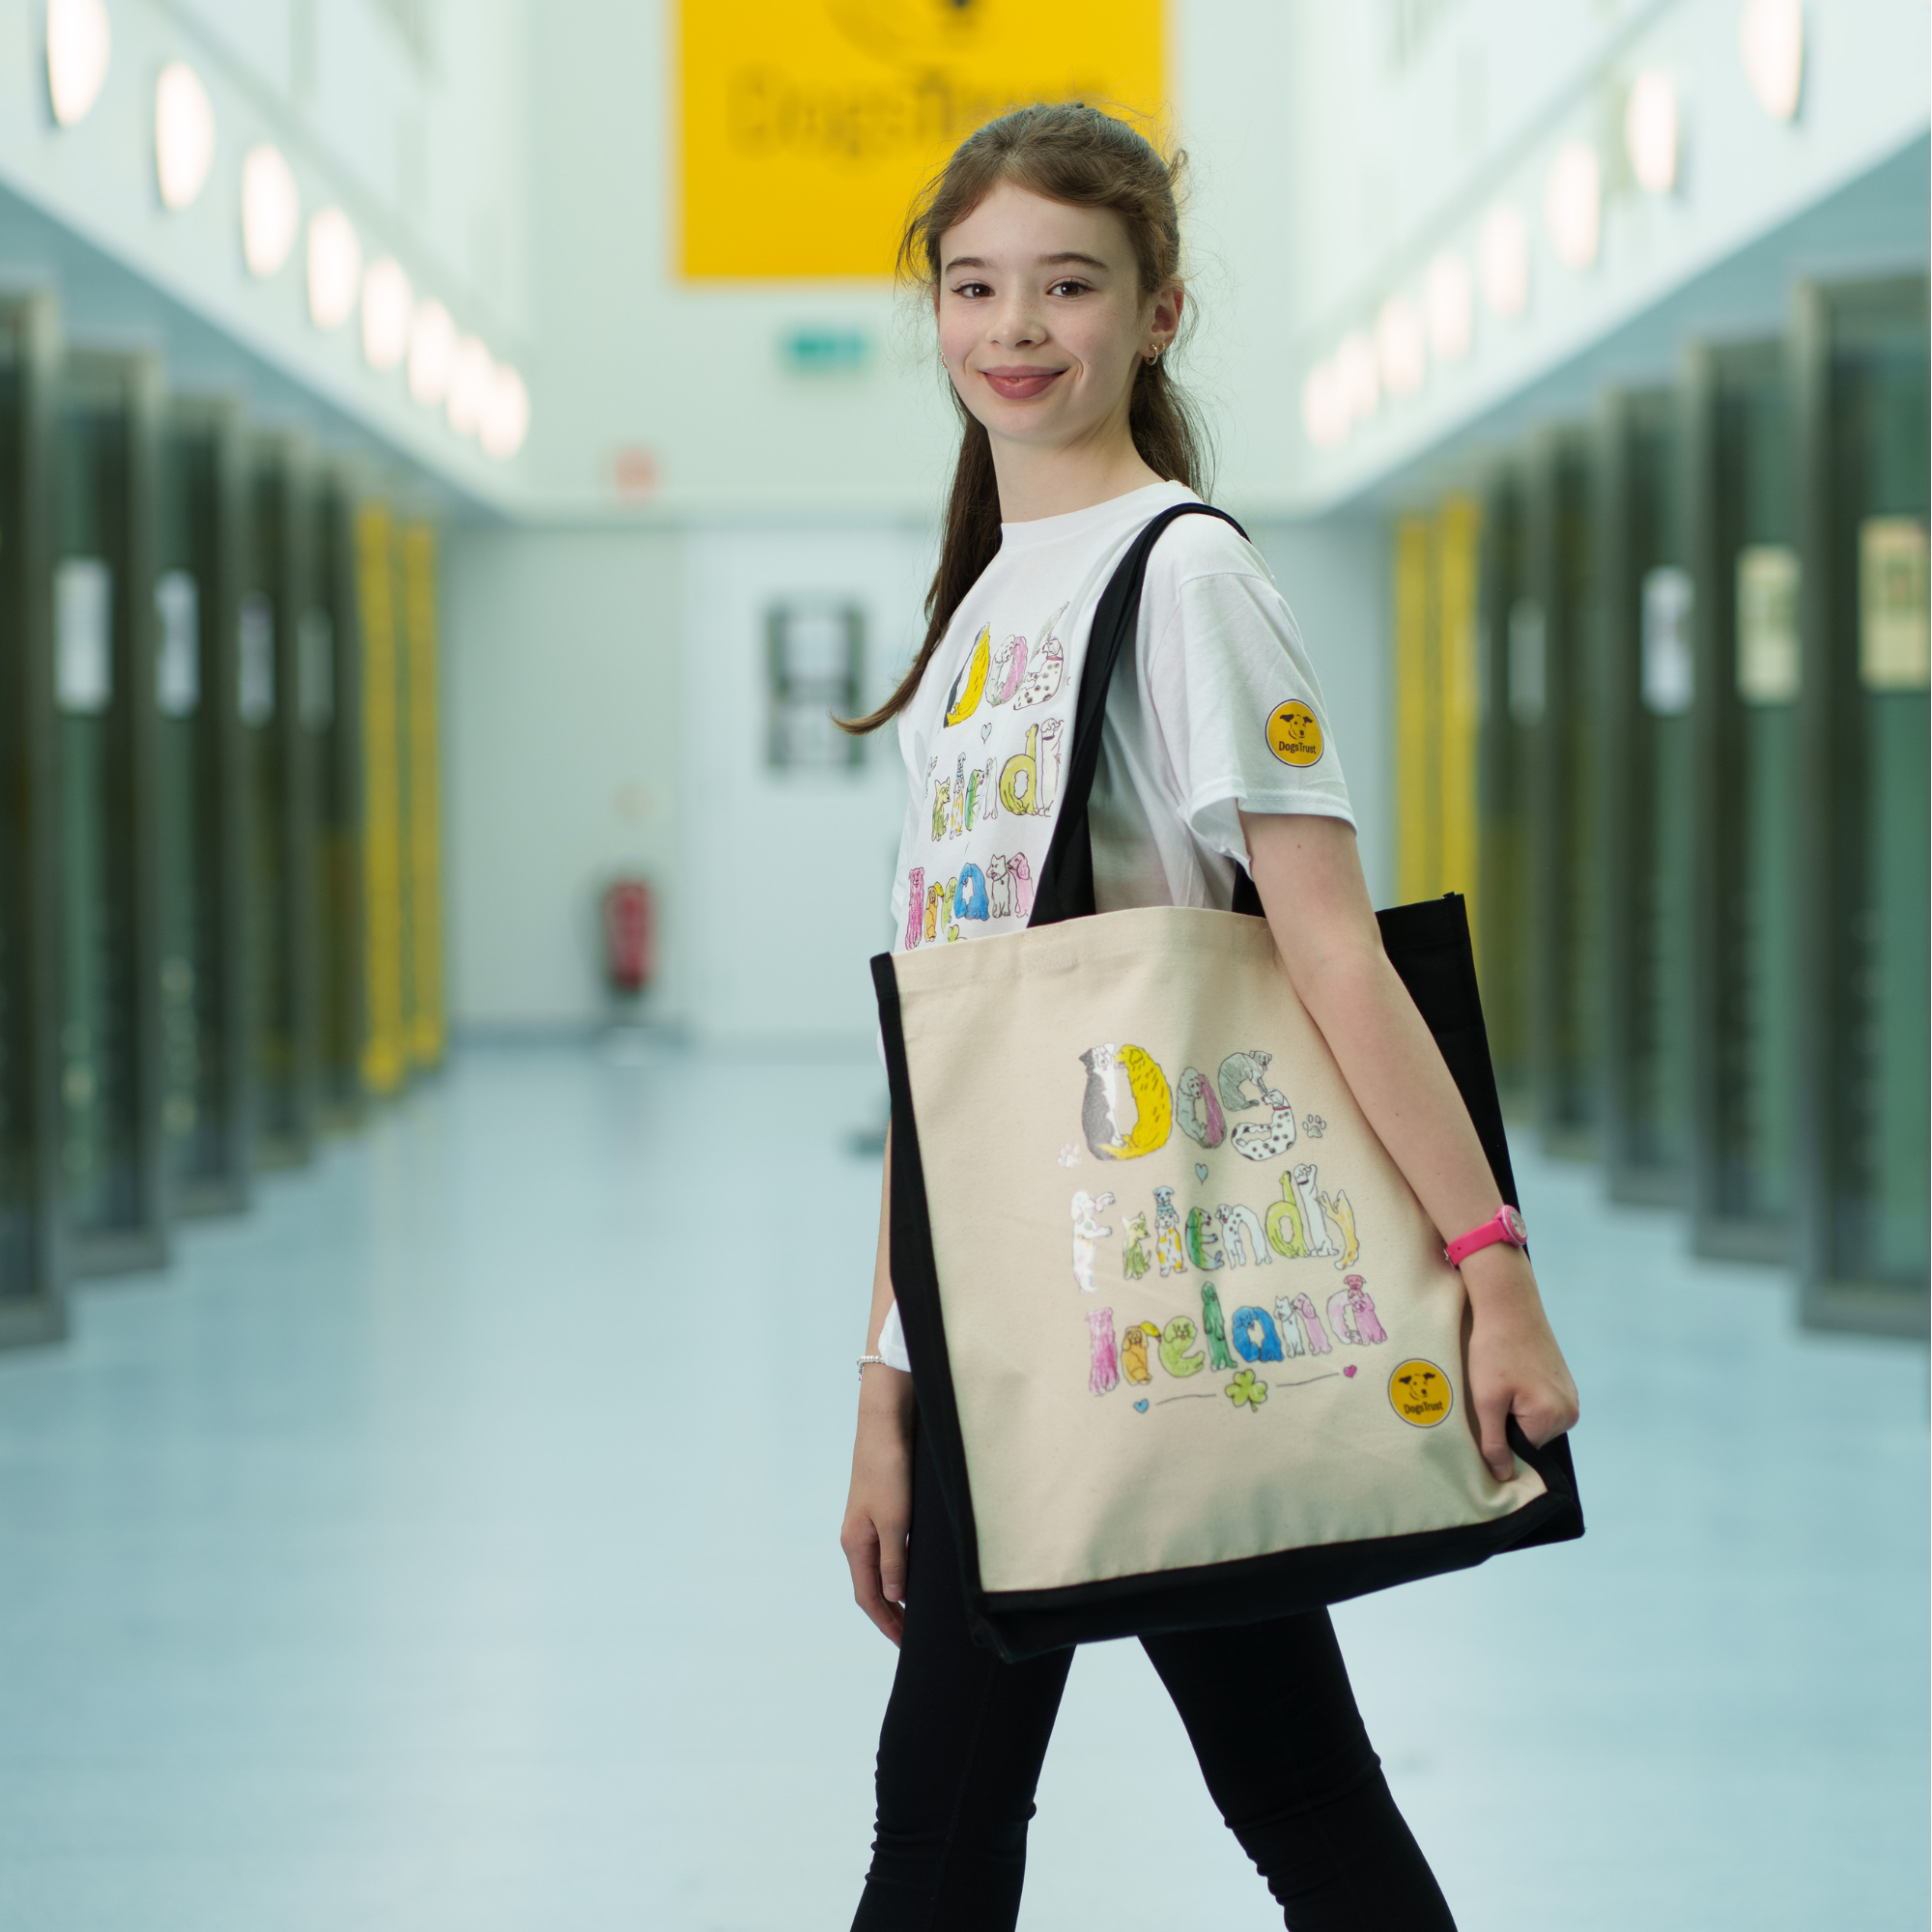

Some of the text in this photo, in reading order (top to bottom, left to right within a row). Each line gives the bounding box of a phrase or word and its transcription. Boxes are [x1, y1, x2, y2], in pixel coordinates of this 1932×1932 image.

[1278, 741, 1317, 754] DogsTrust
[1085, 1274, 1388, 1397] Ireland
[1404, 1401, 1443, 1415] DogsTrust
